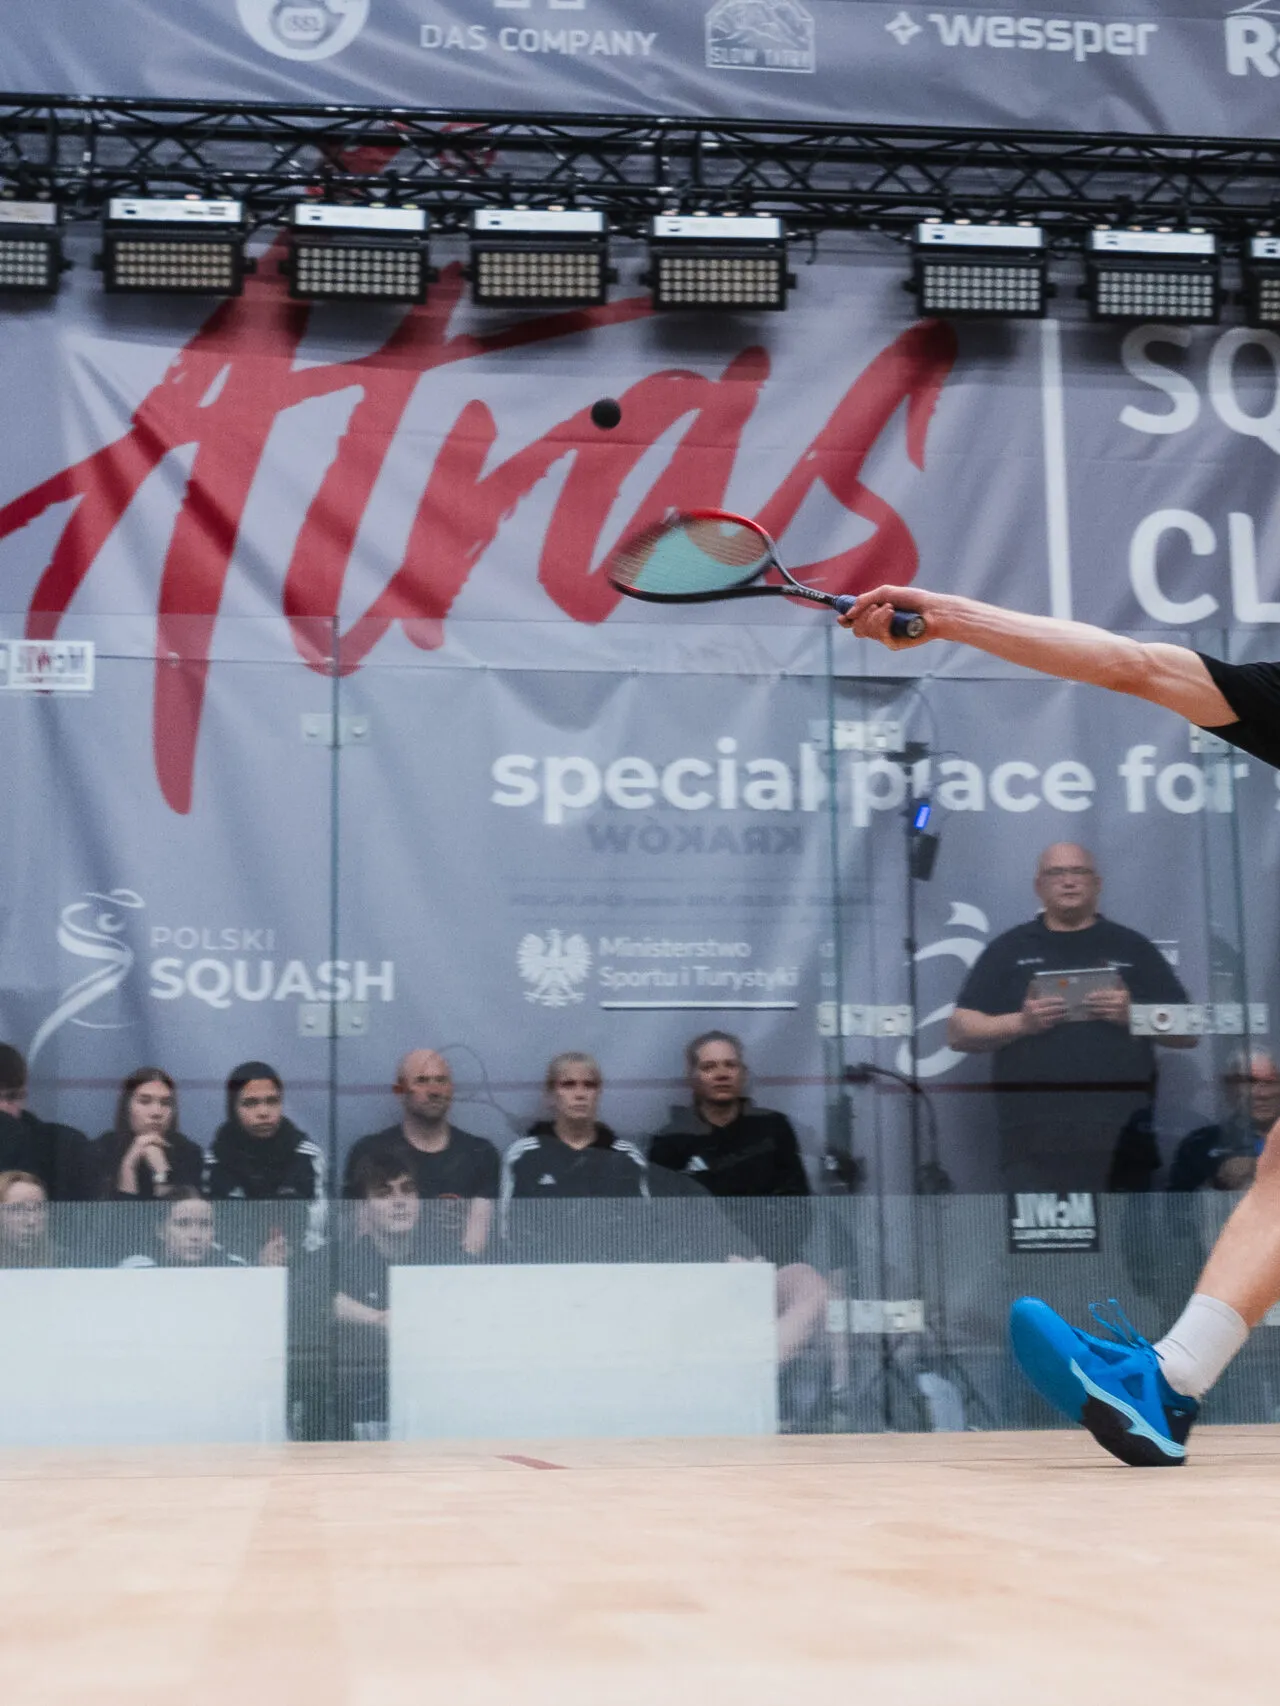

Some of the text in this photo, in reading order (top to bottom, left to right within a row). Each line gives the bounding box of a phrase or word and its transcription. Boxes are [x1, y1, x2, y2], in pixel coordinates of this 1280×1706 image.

[419, 24, 659, 57] DAS COMPANY
[491, 737, 818, 825] special
[1118, 743, 1249, 814] for
[150, 927, 275, 951] POLSKI
[149, 957, 394, 1008] SQUASH
